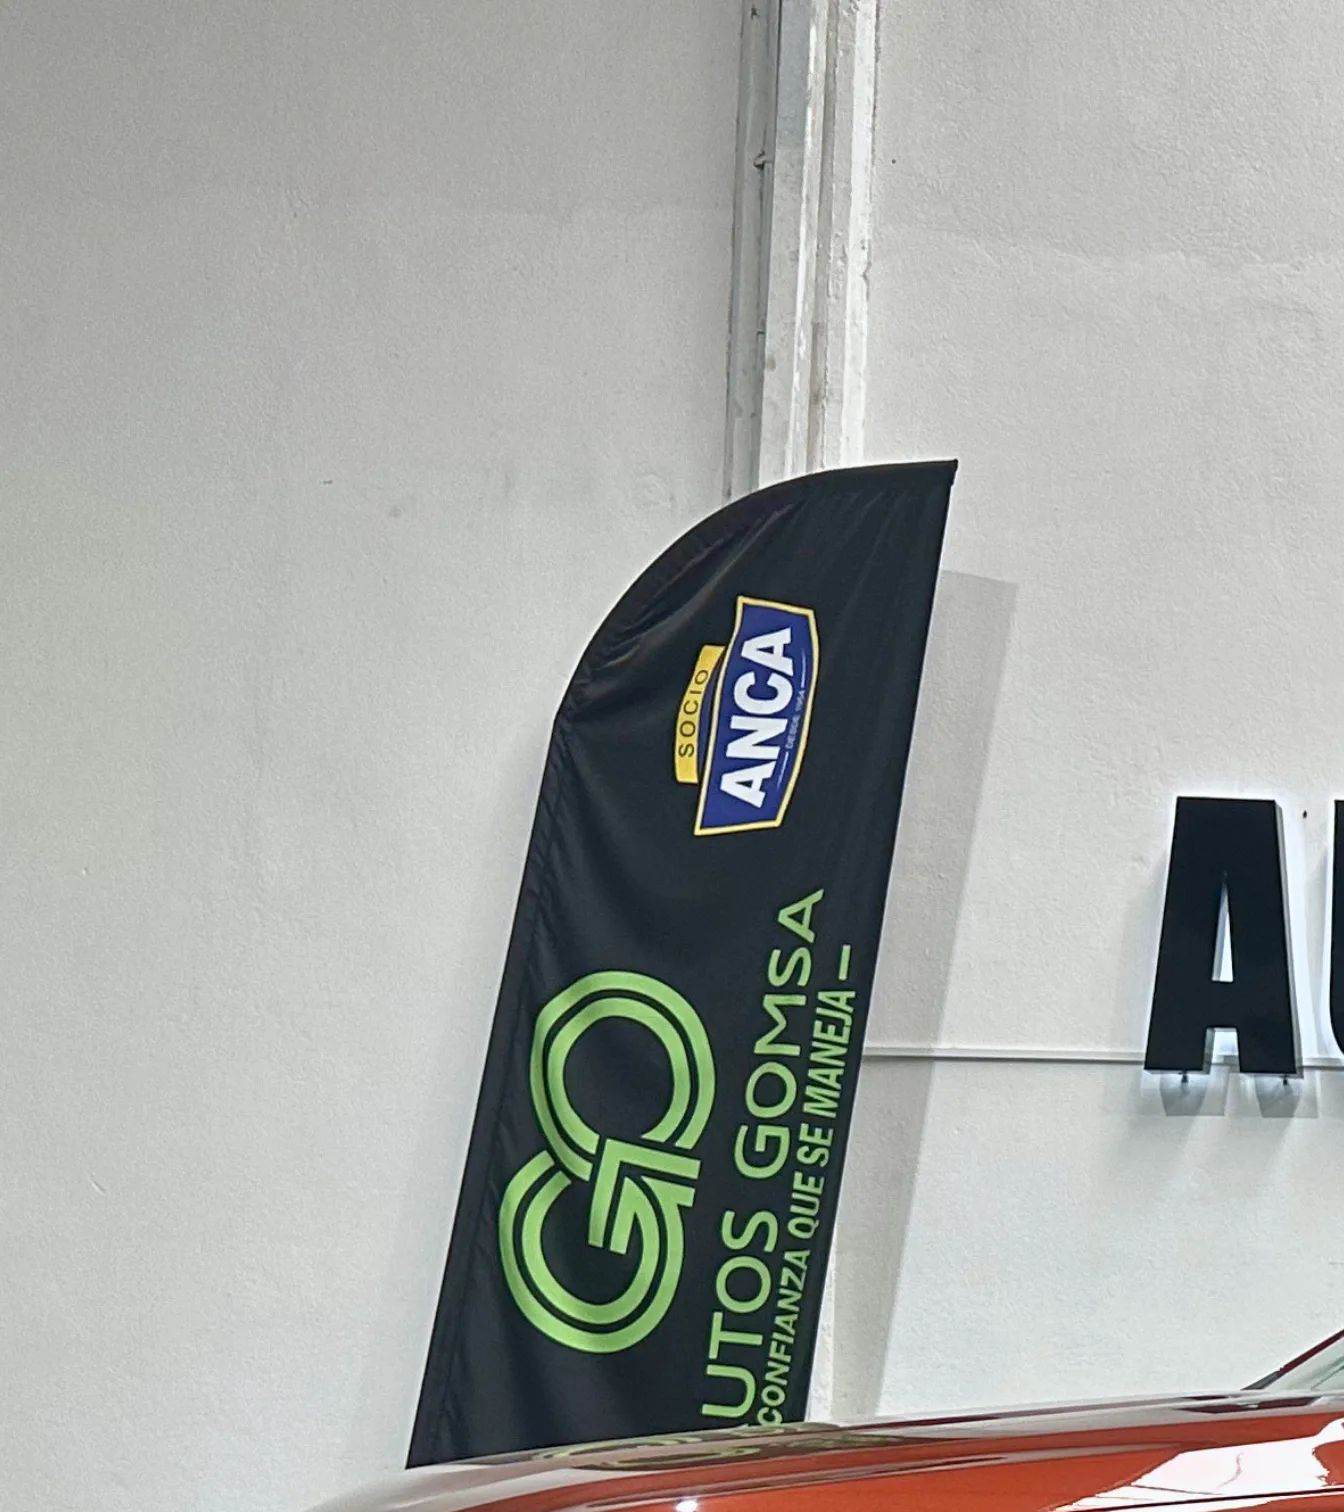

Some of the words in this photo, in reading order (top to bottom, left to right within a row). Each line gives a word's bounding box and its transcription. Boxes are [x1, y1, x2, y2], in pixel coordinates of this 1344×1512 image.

[678, 669, 709, 758] SOCIO
[720, 627, 794, 809] ANCA
[733, 888, 824, 1179] GOMSA
[802, 989, 856, 1116] MANEJA
[786, 1171, 824, 1239] QUE
[796, 1122, 834, 1167] SE
[701, 1209, 779, 1426] UTOS
[757, 1249, 813, 1426] CONFIANZA
